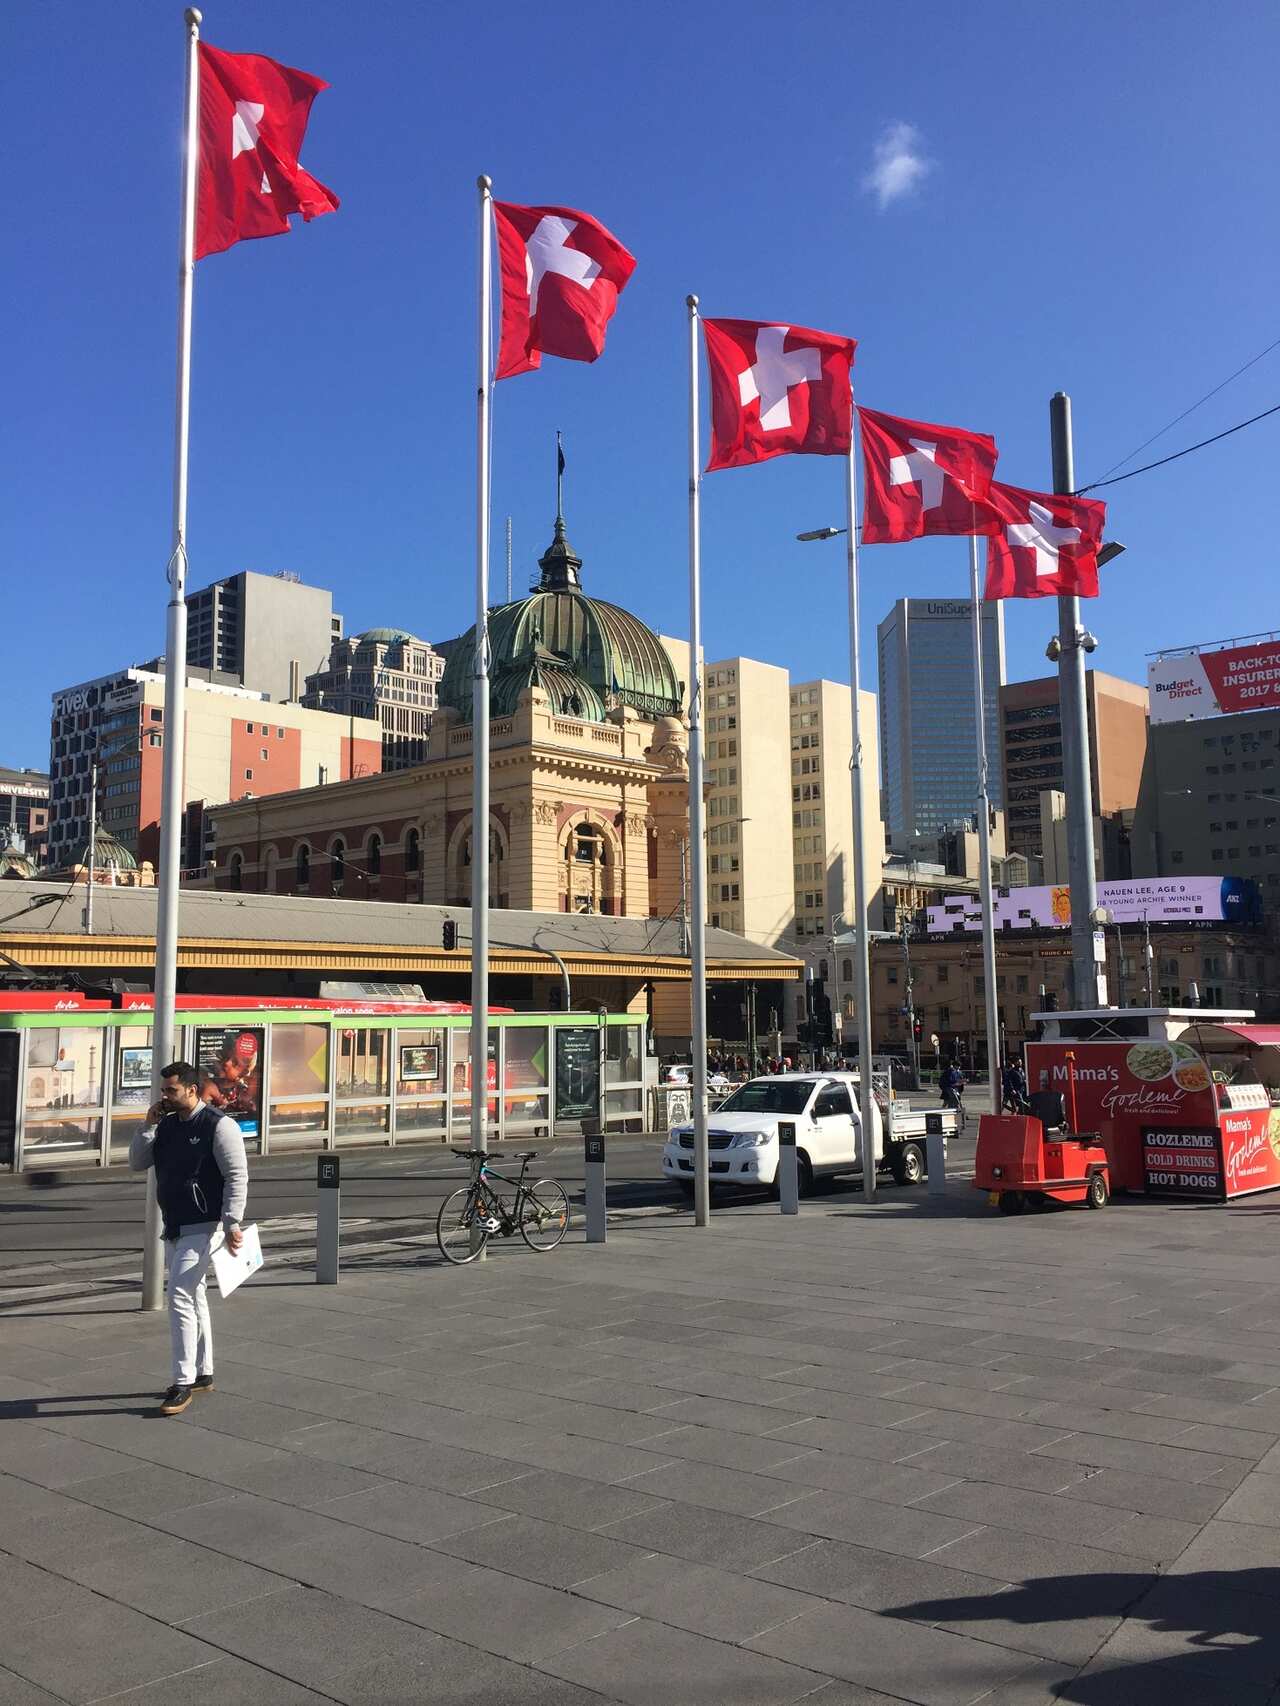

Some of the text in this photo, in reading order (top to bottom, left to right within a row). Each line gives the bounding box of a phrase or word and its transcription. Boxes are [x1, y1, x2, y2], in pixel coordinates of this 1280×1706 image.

[927, 602, 974, 616] UniSupe
[1155, 678, 1195, 693] Budget
[1168, 686, 1202, 699] Direct
[1240, 684, 1270, 698] 2017
[1104, 888, 1133, 896] NAUEN
[1053, 1065, 1119, 1081] Mama's
[1226, 1117, 1252, 1133] Mama's
[1146, 1133, 1214, 1148] GOZLEME
[1147, 1153, 1216, 1168] COLD DRINKS
[1148, 1172, 1217, 1188] HOT DOGS
